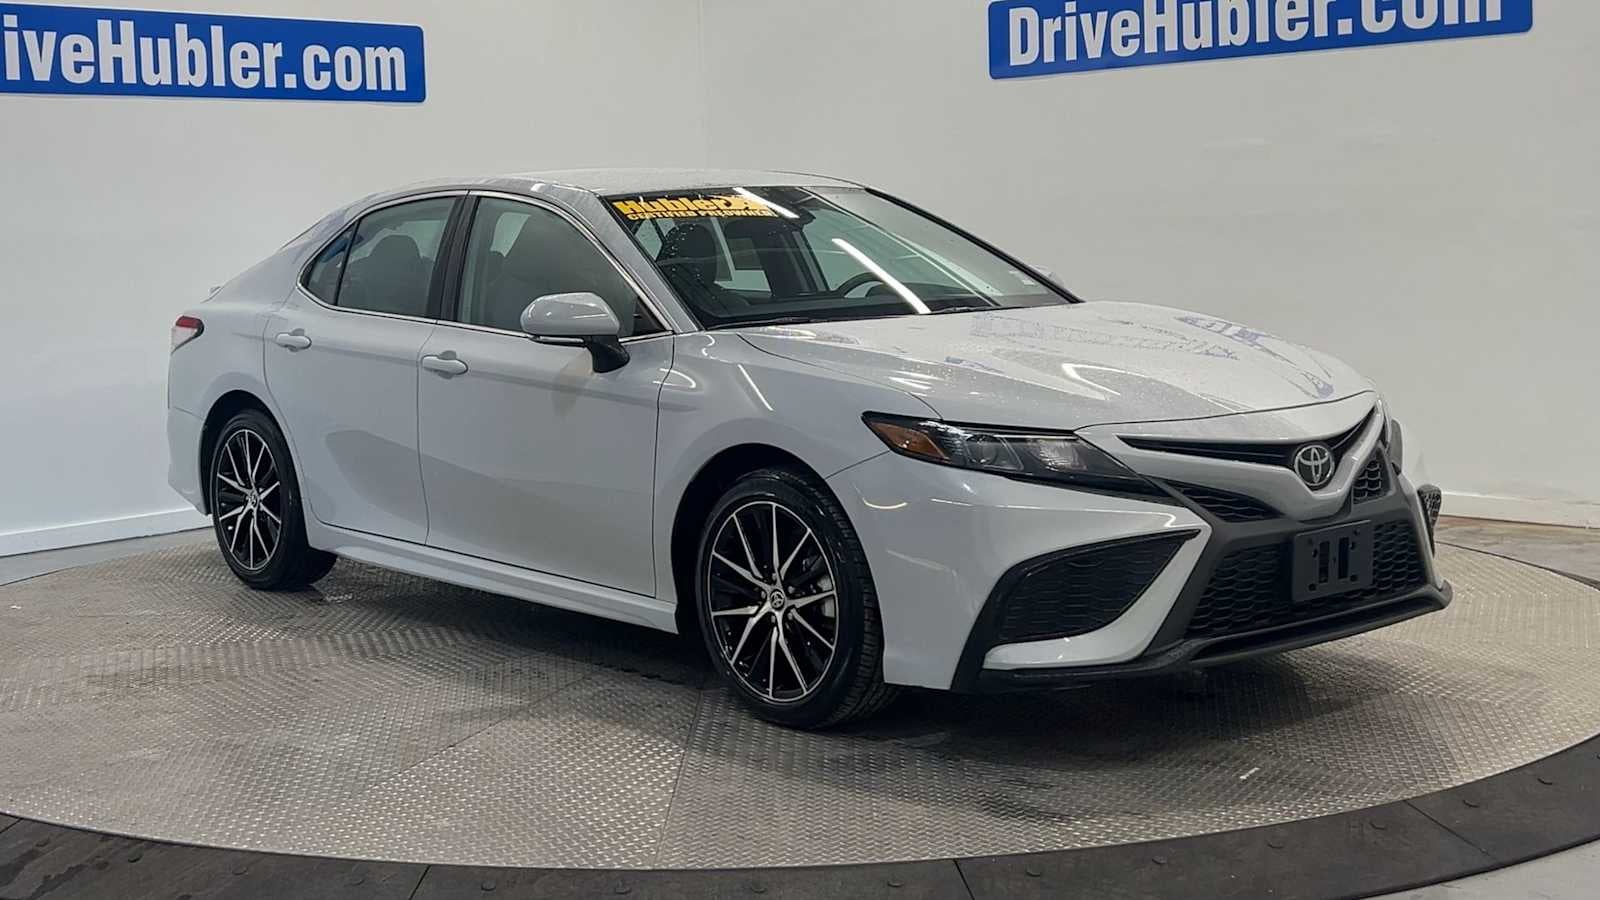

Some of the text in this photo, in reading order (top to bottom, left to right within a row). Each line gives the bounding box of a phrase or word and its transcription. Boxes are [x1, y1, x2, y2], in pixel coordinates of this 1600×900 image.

[3, 14, 407, 91] iveHubler.com
[612, 197, 732, 215] Hubler
[627, 210, 698, 221] CERTIFIED
